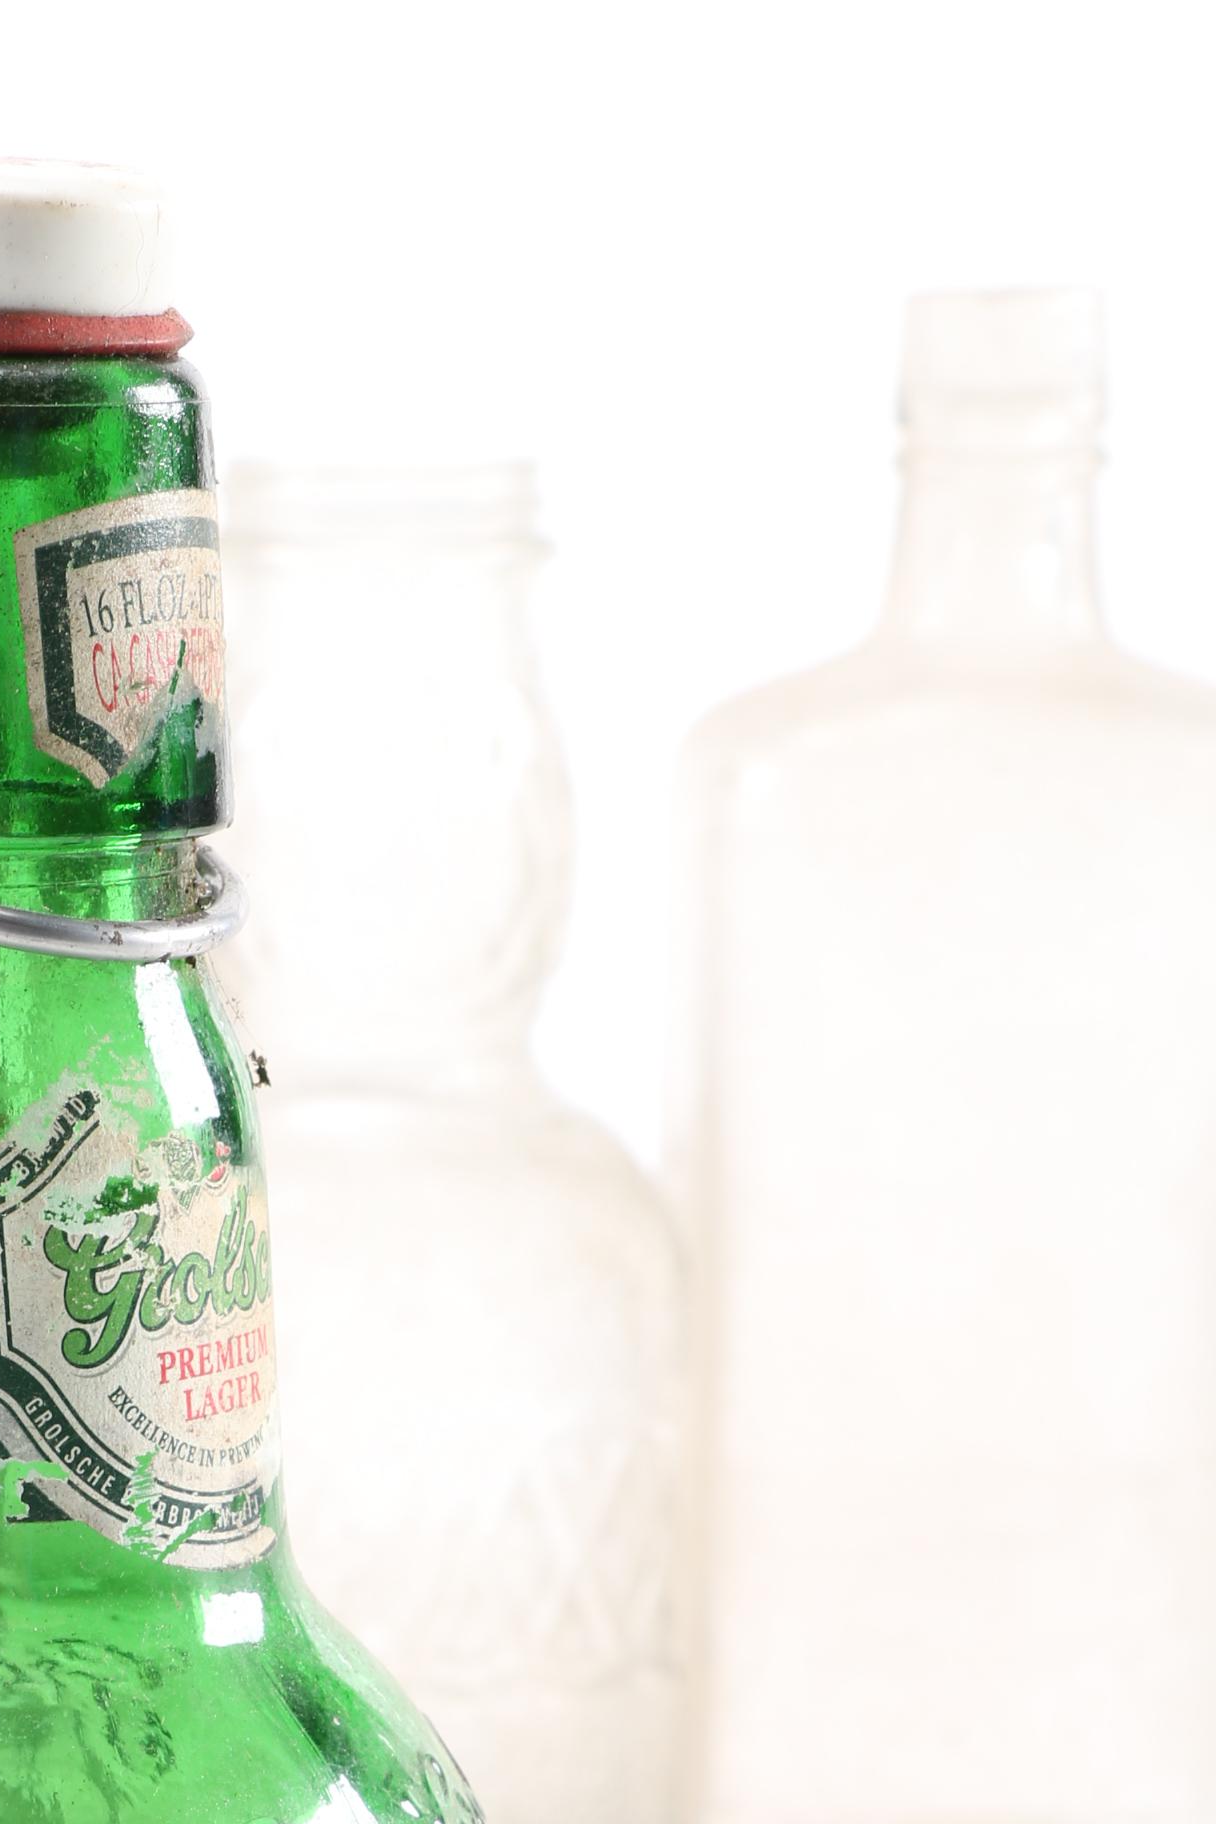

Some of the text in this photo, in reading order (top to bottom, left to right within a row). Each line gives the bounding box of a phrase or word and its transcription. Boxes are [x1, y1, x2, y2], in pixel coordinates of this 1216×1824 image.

[79, 588, 115, 638] 16
[43, 1185, 270, 1370] Grolsc
[157, 1323, 269, 1385] PREMIUM
[107, 1385, 195, 1466] EXCELLENCE
[200, 1449, 214, 1468] IN
[183, 1371, 262, 1422] LAGER
[24, 1397, 116, 1496] GROLSCHE
